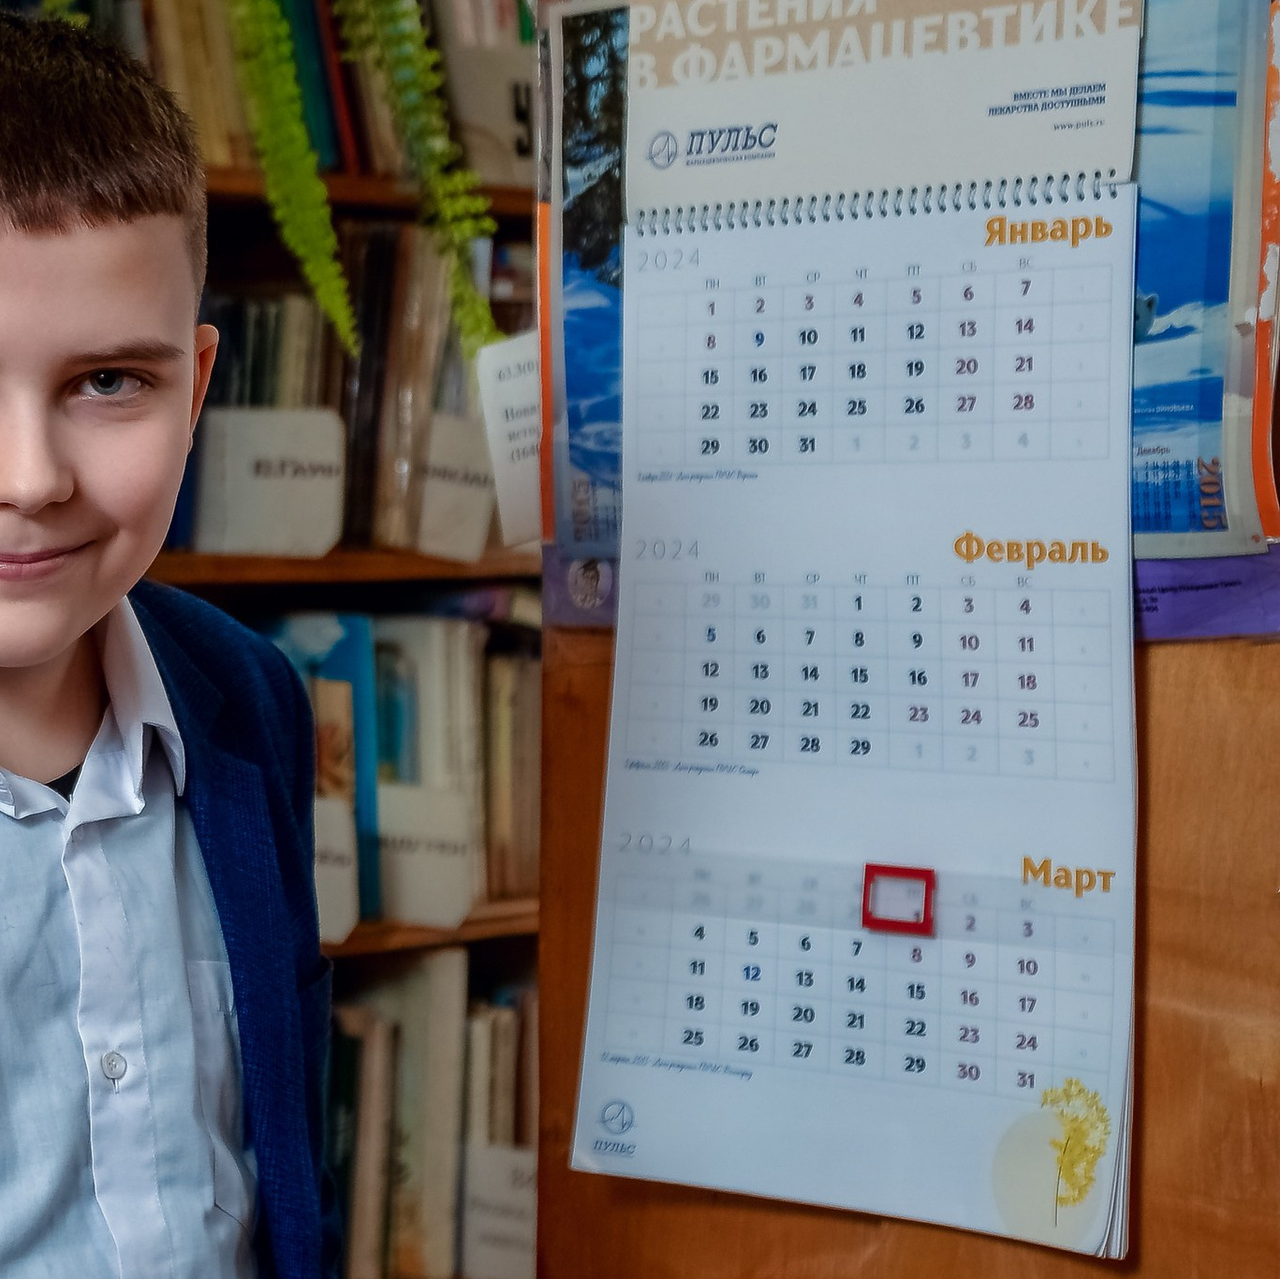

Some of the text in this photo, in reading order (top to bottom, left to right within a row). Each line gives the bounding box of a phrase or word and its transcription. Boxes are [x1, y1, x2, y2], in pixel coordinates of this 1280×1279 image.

[988, 96, 1106, 117] ЛЕКАРСТВА ДОСТУПНЫМИ
[1013, 83, 1106, 102] ВМЕСТЕ МЫ ДЕЛАЕМ
[686, 124, 779, 156] ПУЛЬС
[983, 213, 1114, 248] Январь
[637, 248, 702, 272] 2024
[705, 257, 1034, 290] ПН ВТ СР ЧТ ПТ СБ ВС
[708, 279, 1032, 316] 1 2 3 4 5 6 7
[706, 318, 1034, 350] 8 9 10 11 12 13 14
[702, 356, 1033, 385] 15 16 17 18 19 20 21
[701, 393, 1035, 420] 22 23 24 25 26 27 28
[701, 437, 816, 455] 29 30 31
[1197, 457, 1229, 531] 2015
[635, 539, 702, 562] 2024
[953, 530, 1110, 571] Февраль
[704, 571, 1033, 588] ПН ВТ СР ЧТ ПТ СБ ВС
[854, 595, 862, 611] 1
[912, 596, 922, 613] 2
[963, 597, 975, 614] 3
[1019, 598, 1031, 615] 4
[706, 627, 1034, 653] 5 6 7 8 9 10 11
[702, 661, 1038, 691] 12 13 14 15 16 17 18
[701, 696, 1040, 728] 19 20 21 22 23 24 25
[698, 731, 871, 756] 26 27 28 29
[618, 832, 693, 855] 2024
[1021, 855, 1116, 898] Март
[965, 914, 976, 932] 2
[1023, 921, 1034, 938] 3
[693, 925, 1039, 976] 4 5 6 7 8 9 10
[689, 960, 1037, 1013] 11 12 13 14 15 16 17
[686, 994, 1038, 1051] 18 19 20 21 22 23 24
[682, 1029, 1035, 1089] 25 26 27 28 29 30 31
[593, 1139, 637, 1155] ПУЛЬС
